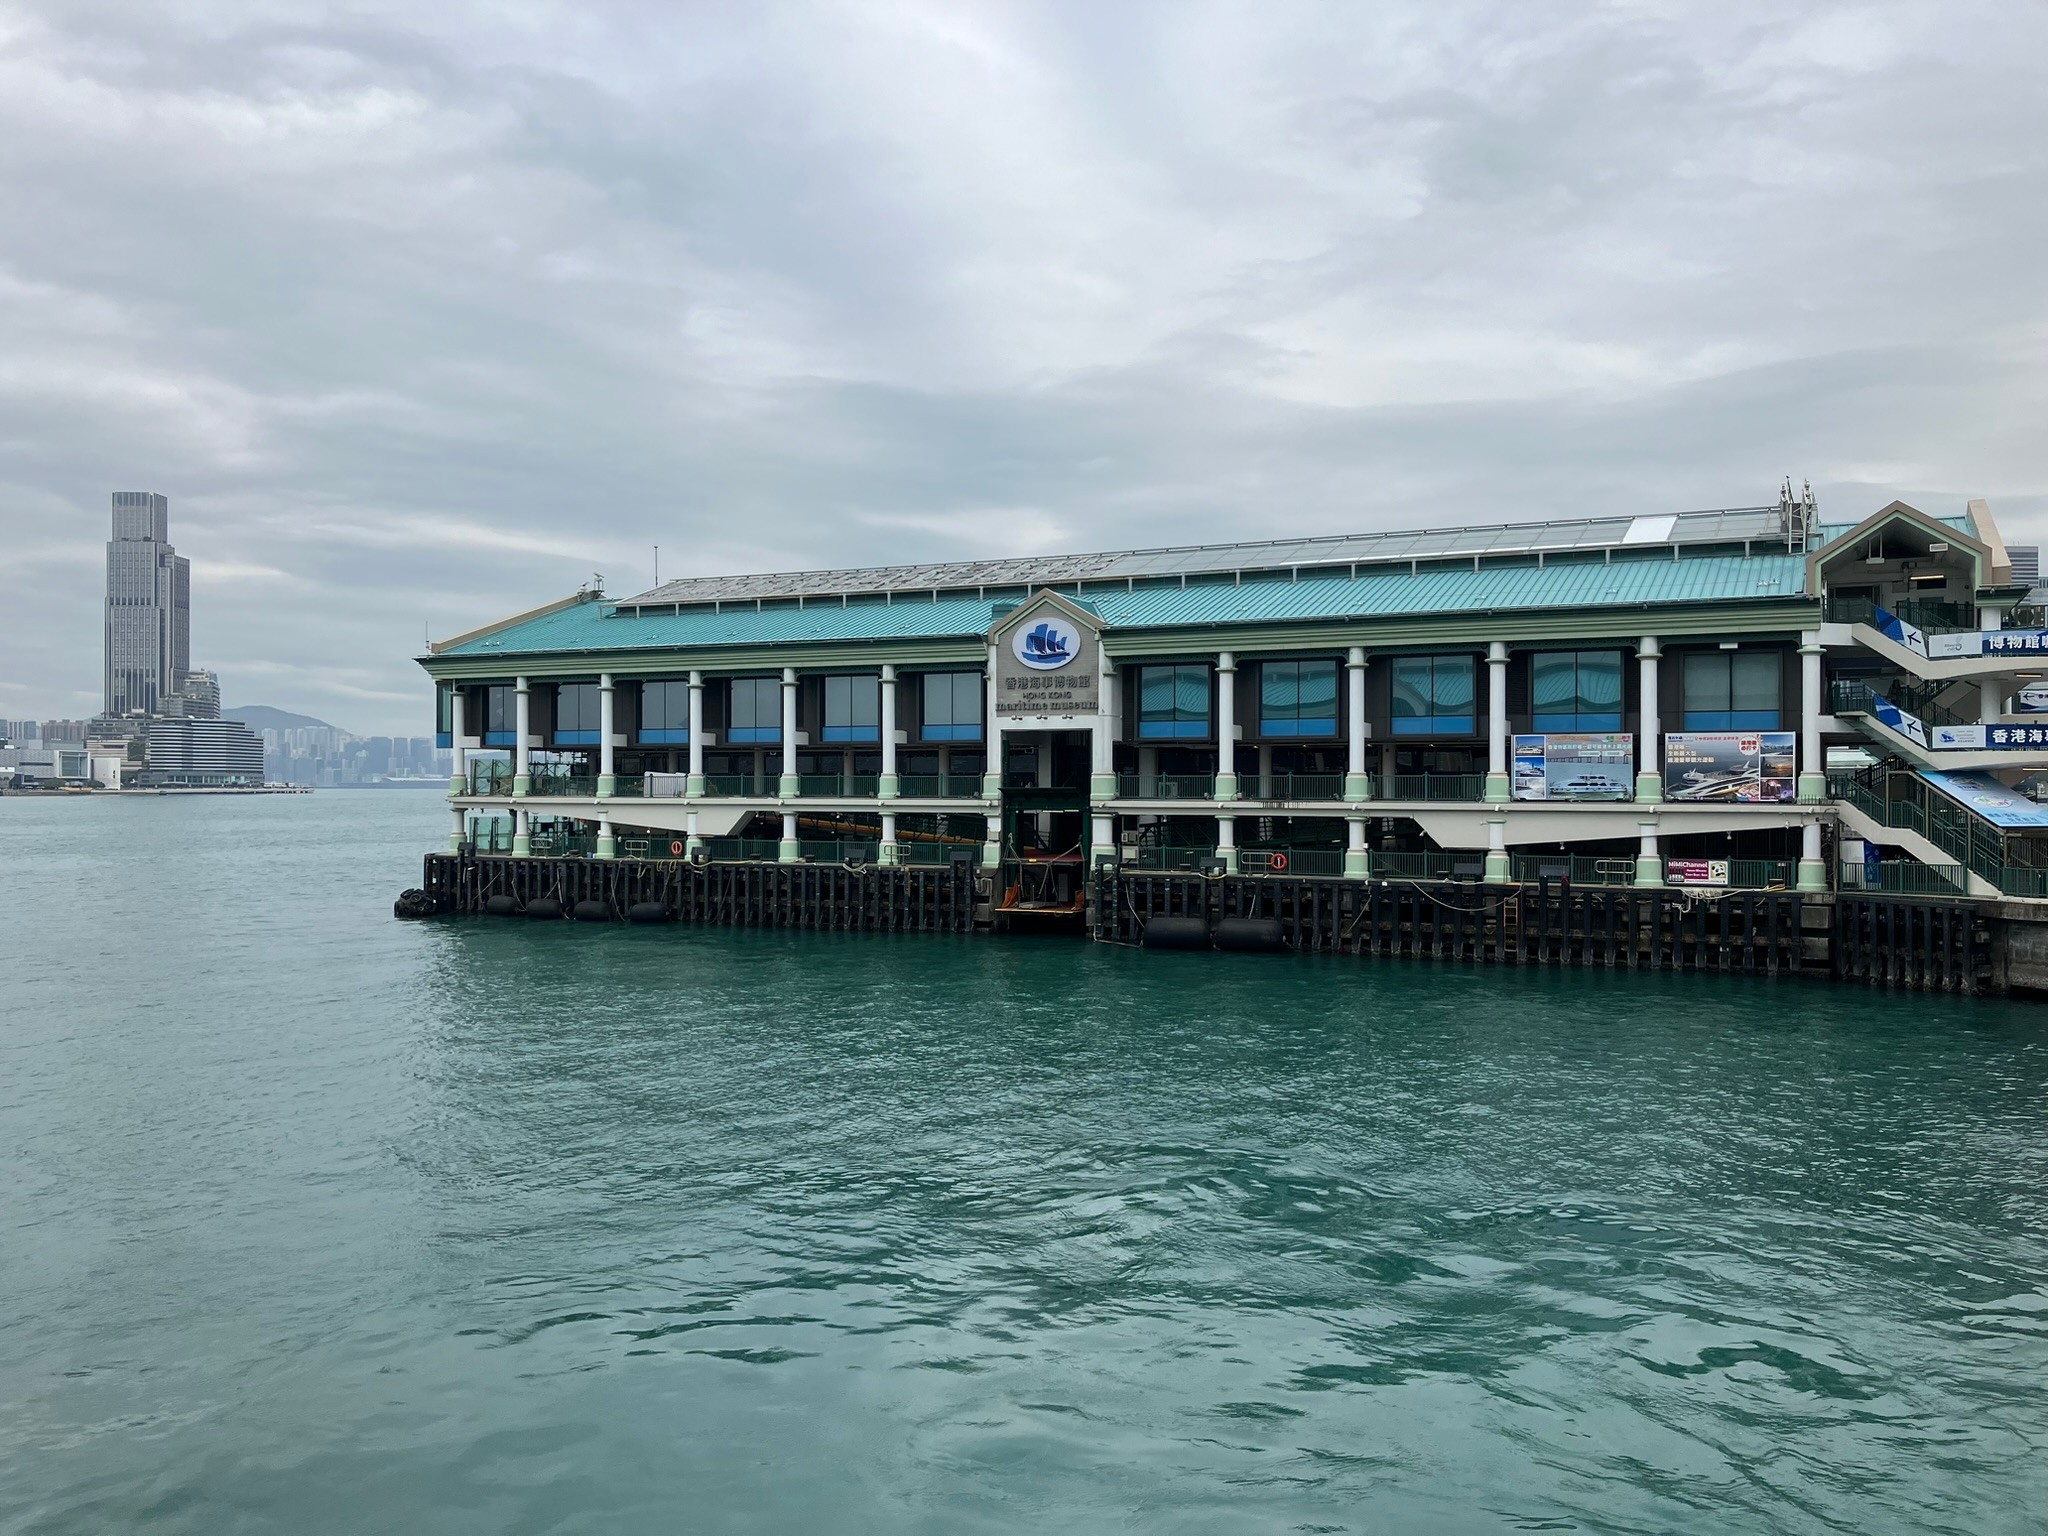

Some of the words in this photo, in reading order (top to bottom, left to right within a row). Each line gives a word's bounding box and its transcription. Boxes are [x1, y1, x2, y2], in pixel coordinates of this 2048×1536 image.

[1005, 675, 1091, 690] 香港海事博物館
[1022, 692, 1047, 700] HONG
[1048, 691, 1072, 700] KONG
[996, 700, 1048, 711] maritime
[1049, 701, 1099, 711] museum
